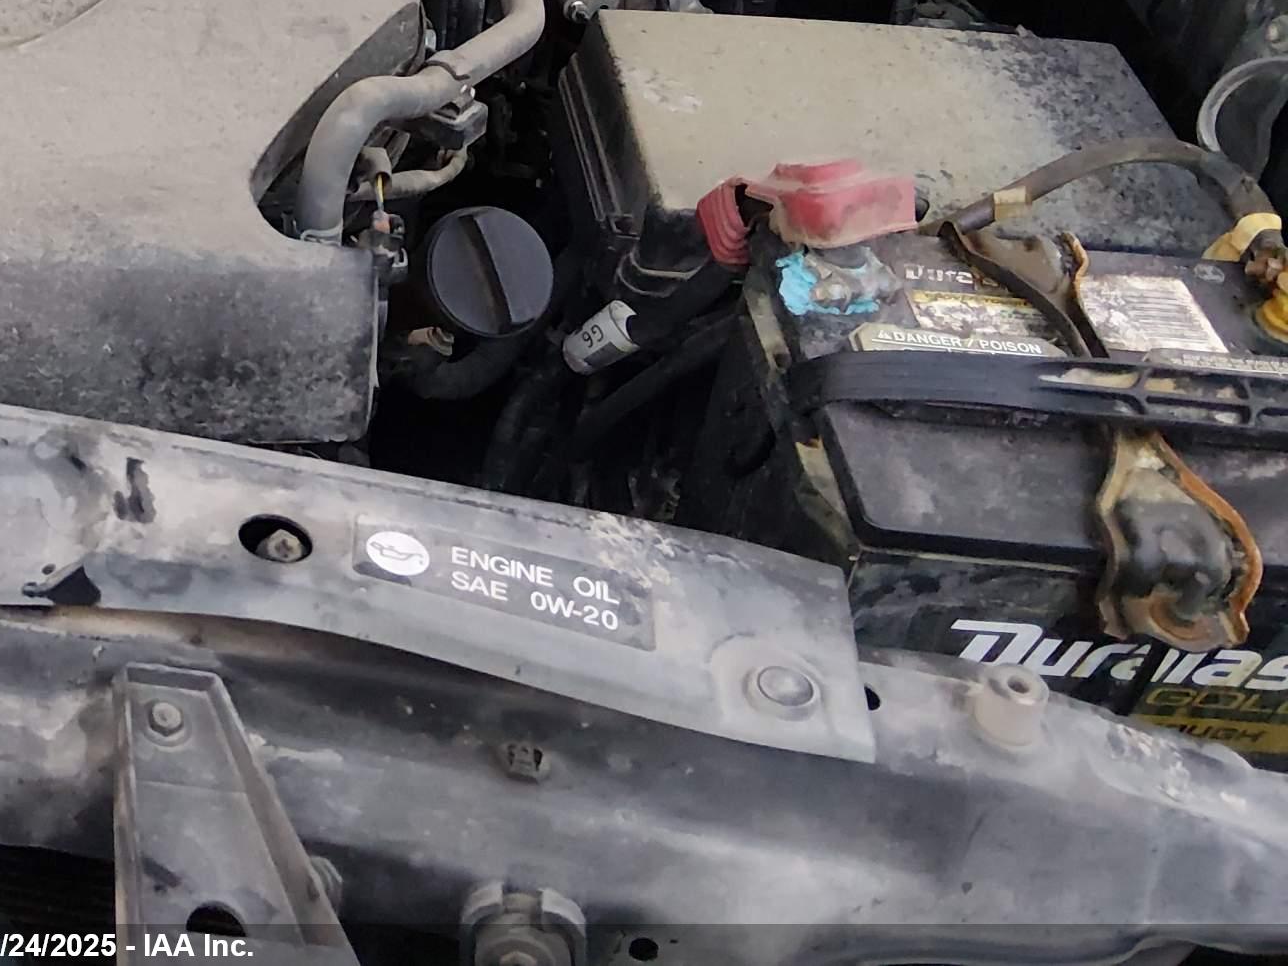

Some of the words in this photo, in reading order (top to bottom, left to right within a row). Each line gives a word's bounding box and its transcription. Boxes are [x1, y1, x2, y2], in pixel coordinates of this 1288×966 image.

[893, 330, 962, 348] DANGER
[979, 339, 1043, 354] POISON
[451, 546, 554, 587] ENGINE
[573, 576, 620, 605] OIL
[451, 571, 509, 601] SAE
[530, 590, 619, 631] 0W-20
[1146, 687, 1288, 715] GOL
